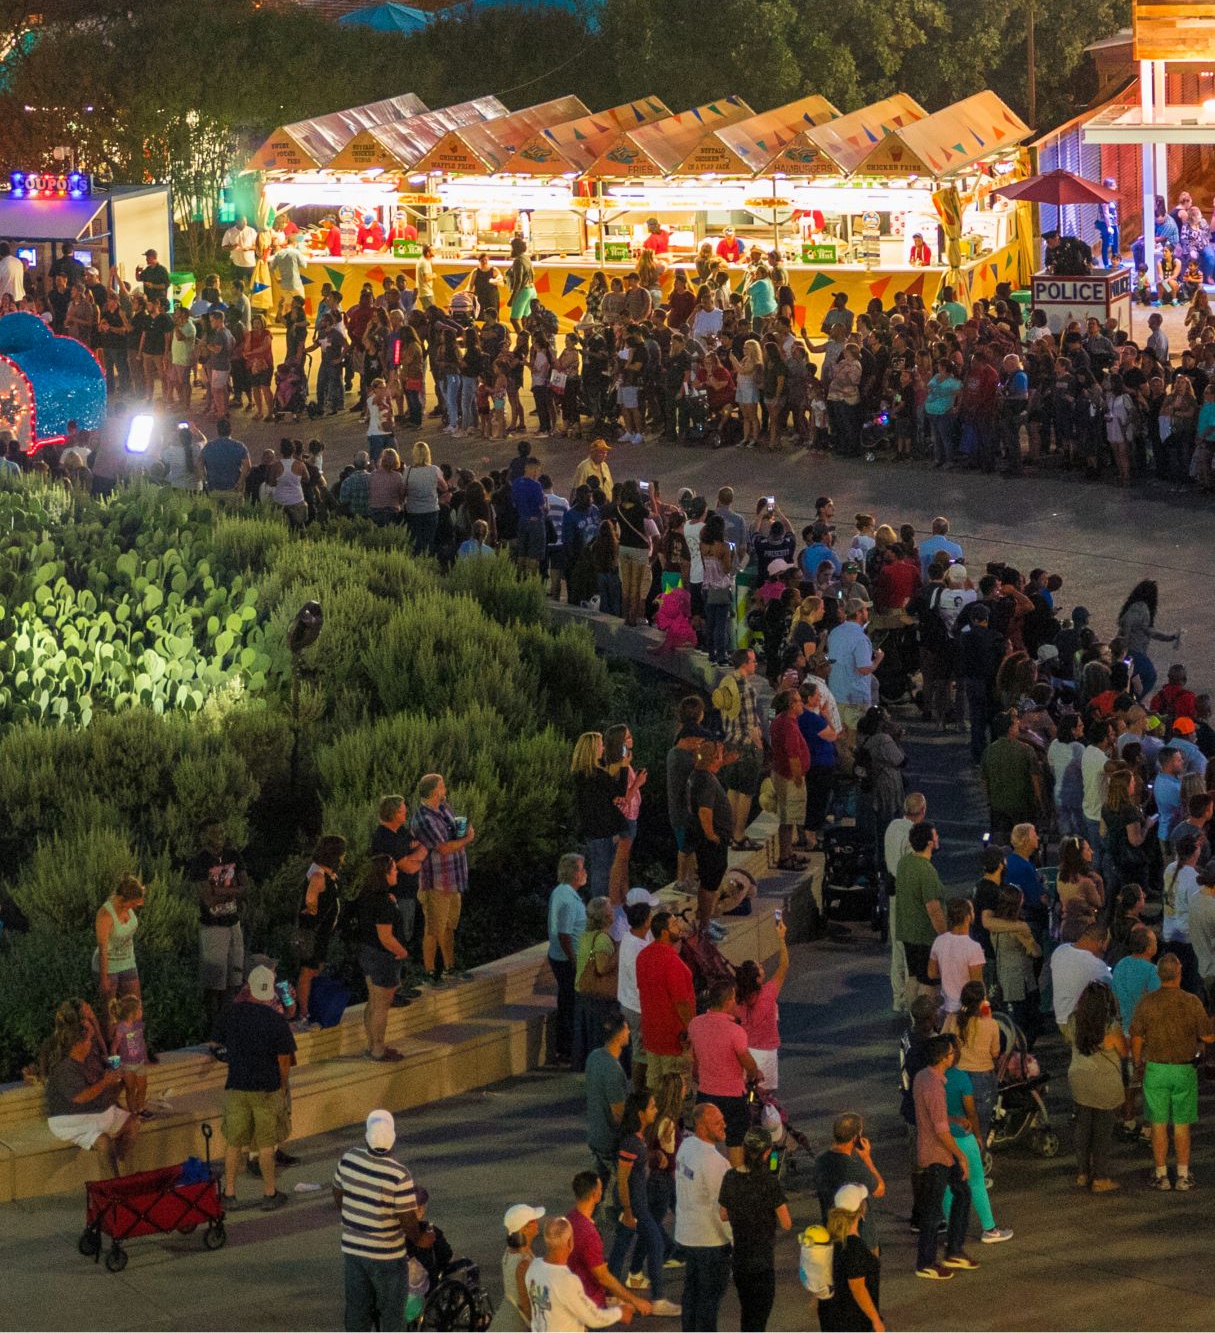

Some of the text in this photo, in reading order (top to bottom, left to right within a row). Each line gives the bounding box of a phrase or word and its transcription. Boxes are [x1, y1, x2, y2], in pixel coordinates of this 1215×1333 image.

[627, 165, 654, 174] FRIES
[774, 164, 833, 173] HAMBURGERS
[13, 176, 89, 193] COUPONS
[1035, 282, 1104, 301] POLICE
